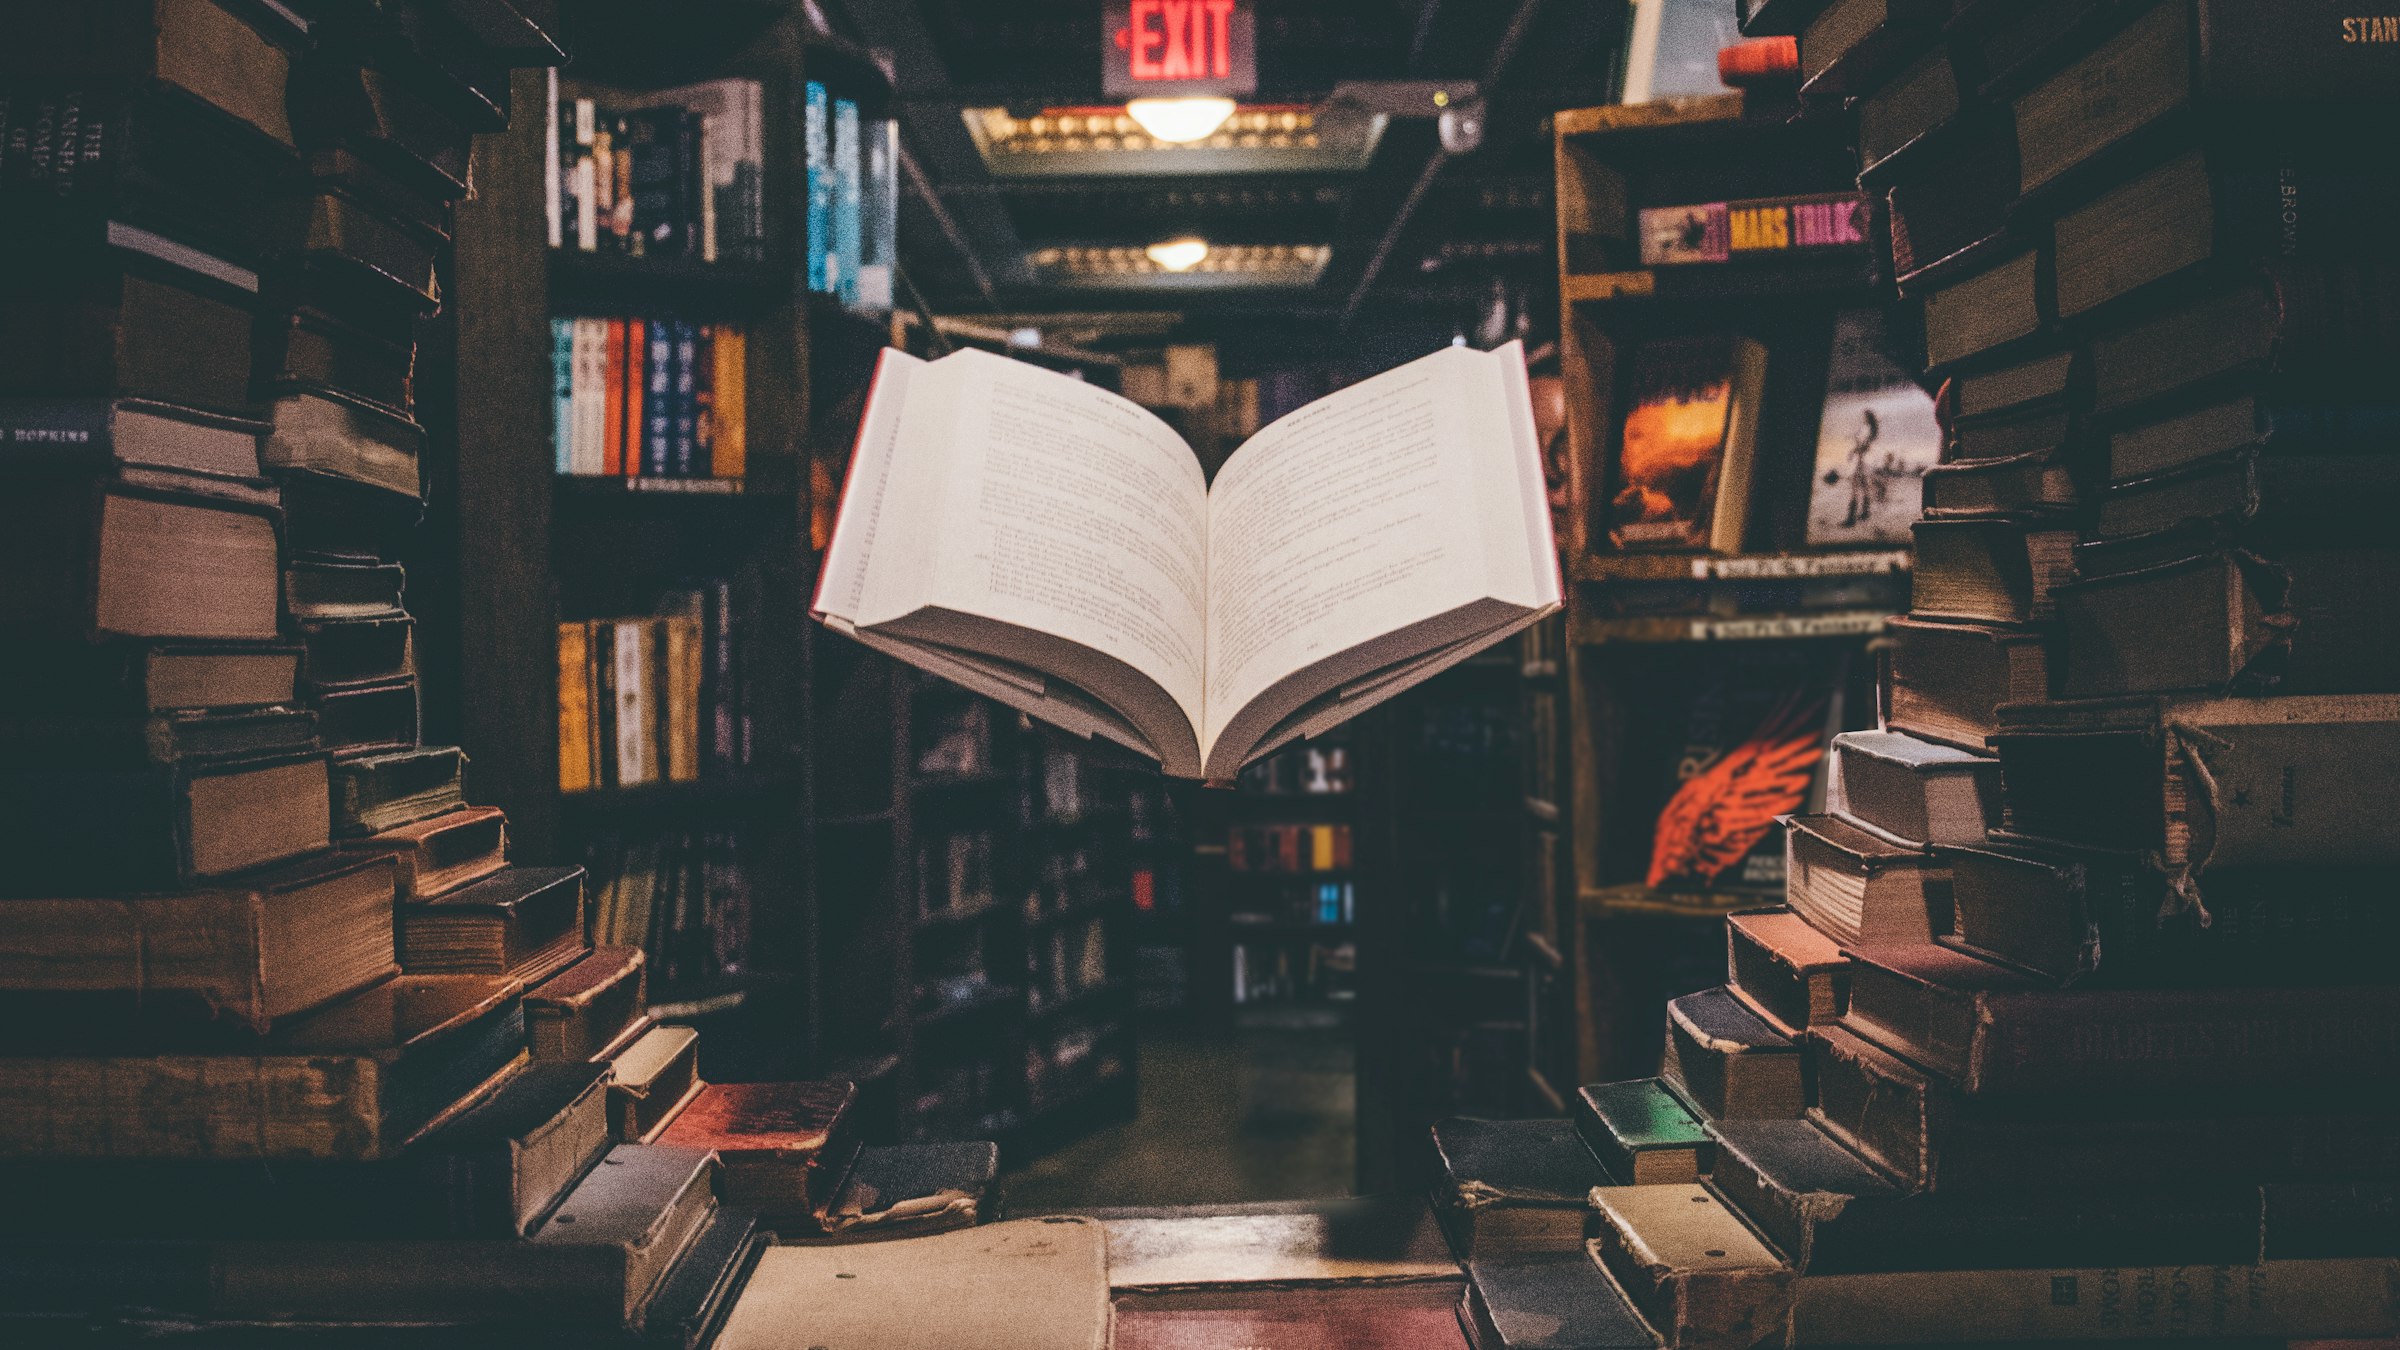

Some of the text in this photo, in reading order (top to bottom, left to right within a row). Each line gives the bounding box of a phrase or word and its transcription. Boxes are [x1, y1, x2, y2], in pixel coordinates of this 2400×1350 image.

[1130, 0, 1236, 80] EXIT
[2342, 16, 2400, 44] STAN
[1730, 205, 1789, 251] MARS
[14, 427, 90, 444] HOPKINS
[1676, 678, 1725, 781] RISIN
